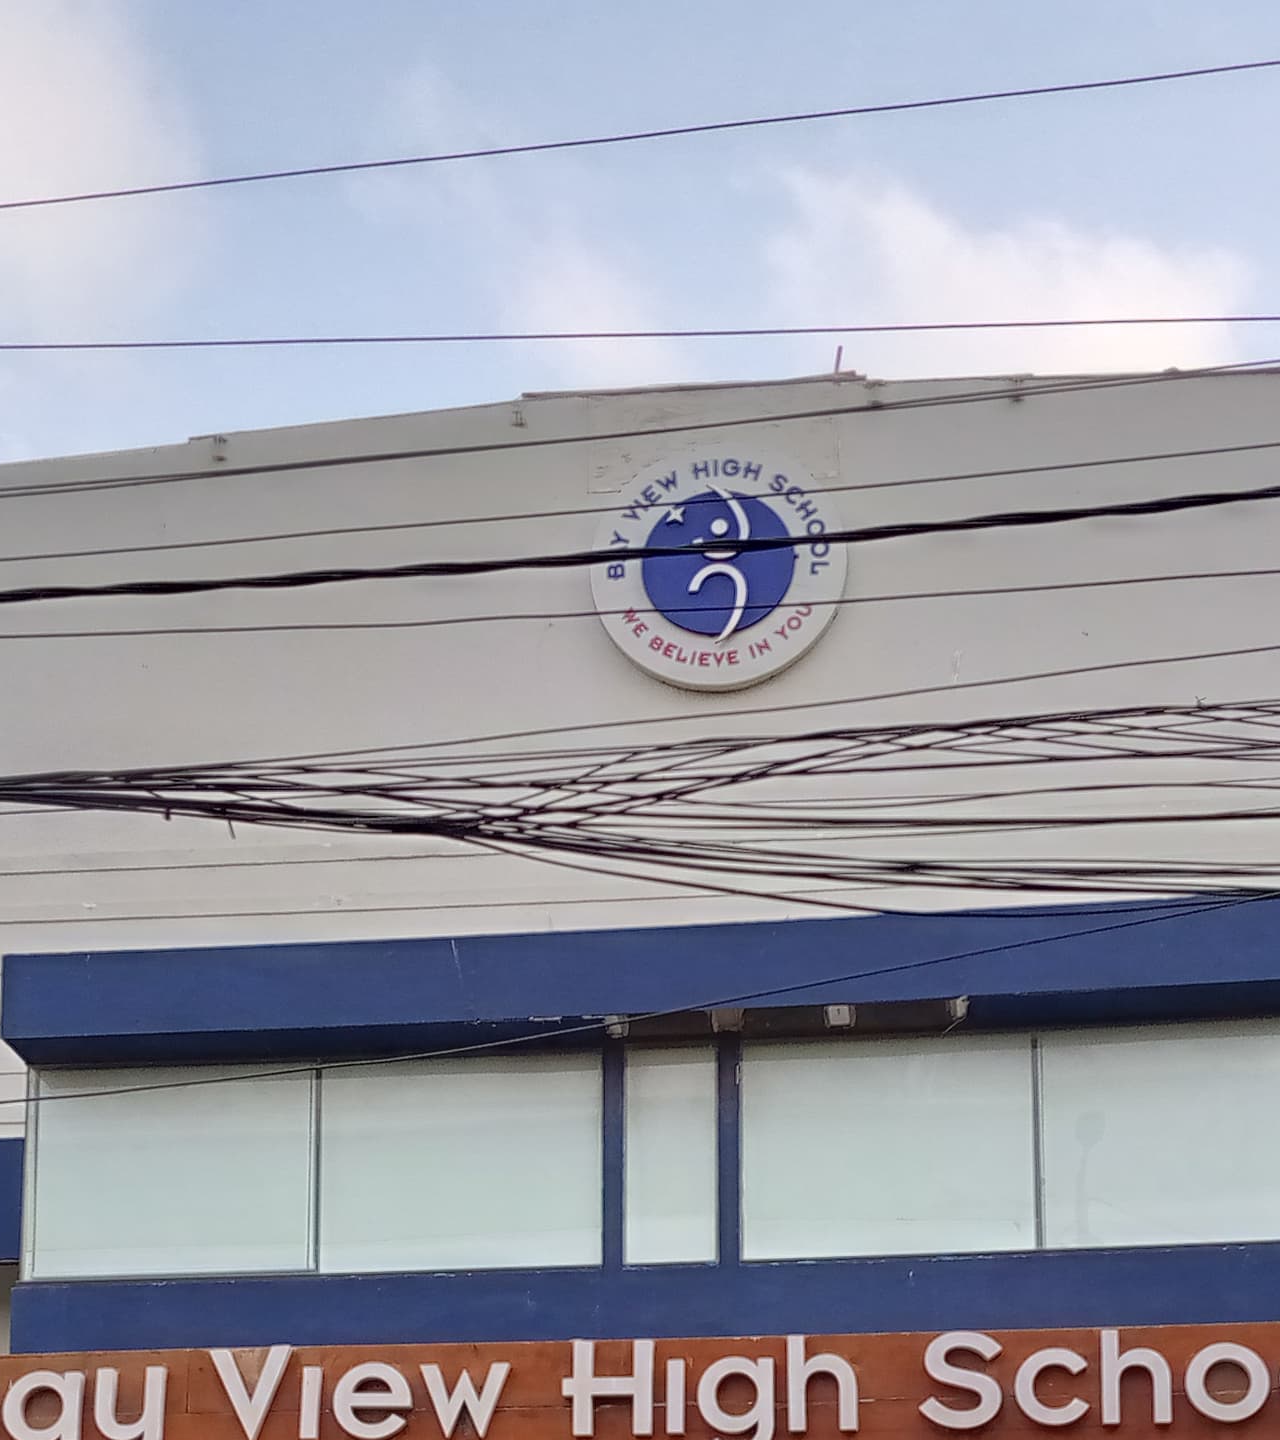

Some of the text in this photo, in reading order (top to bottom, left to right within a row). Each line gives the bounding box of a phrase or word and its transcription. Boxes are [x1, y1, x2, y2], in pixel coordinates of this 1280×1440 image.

[607, 458, 830, 580] BY VIEW HIGH SCHOOL
[622, 603, 813, 667] WE BELIEVE IN YOU
